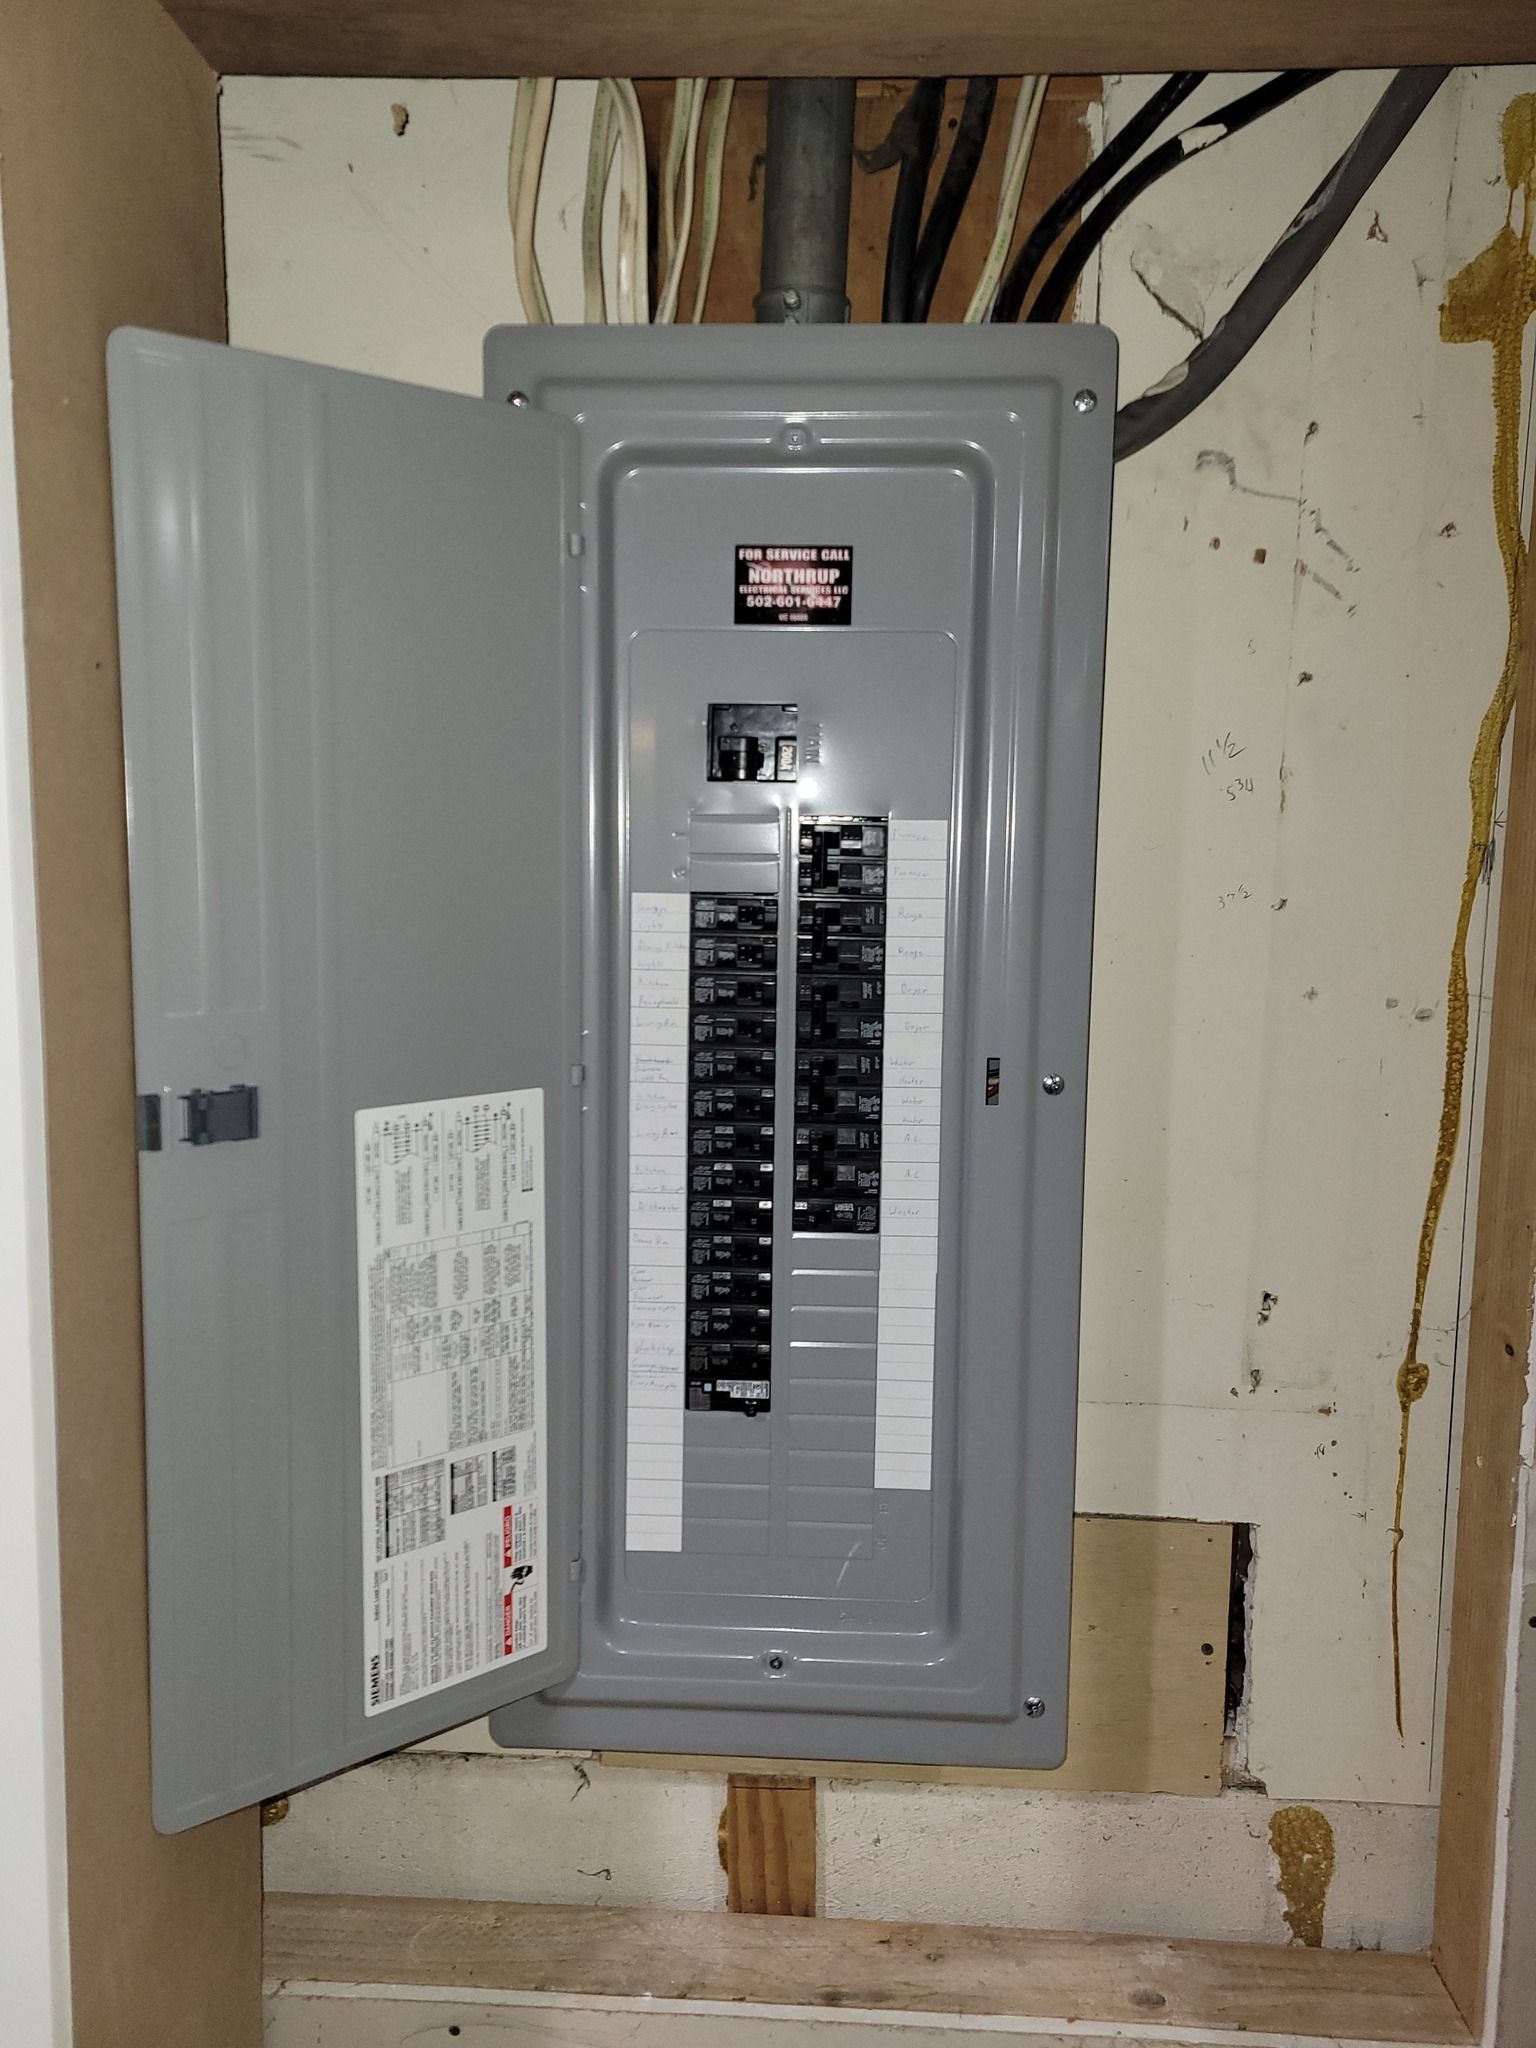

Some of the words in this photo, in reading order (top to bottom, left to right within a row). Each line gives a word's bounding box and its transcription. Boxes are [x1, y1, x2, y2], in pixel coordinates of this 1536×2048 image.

[738, 548, 762, 561] FOR
[766, 548, 817, 561] SERVICE
[821, 548, 850, 561] CALL
[748, 567, 841, 584] NORTHRUP
[739, 584, 788, 594] ELECTRICAL
[780, 745, 794, 770] 200A
[370, 1654, 380, 1706] SIEMENS
